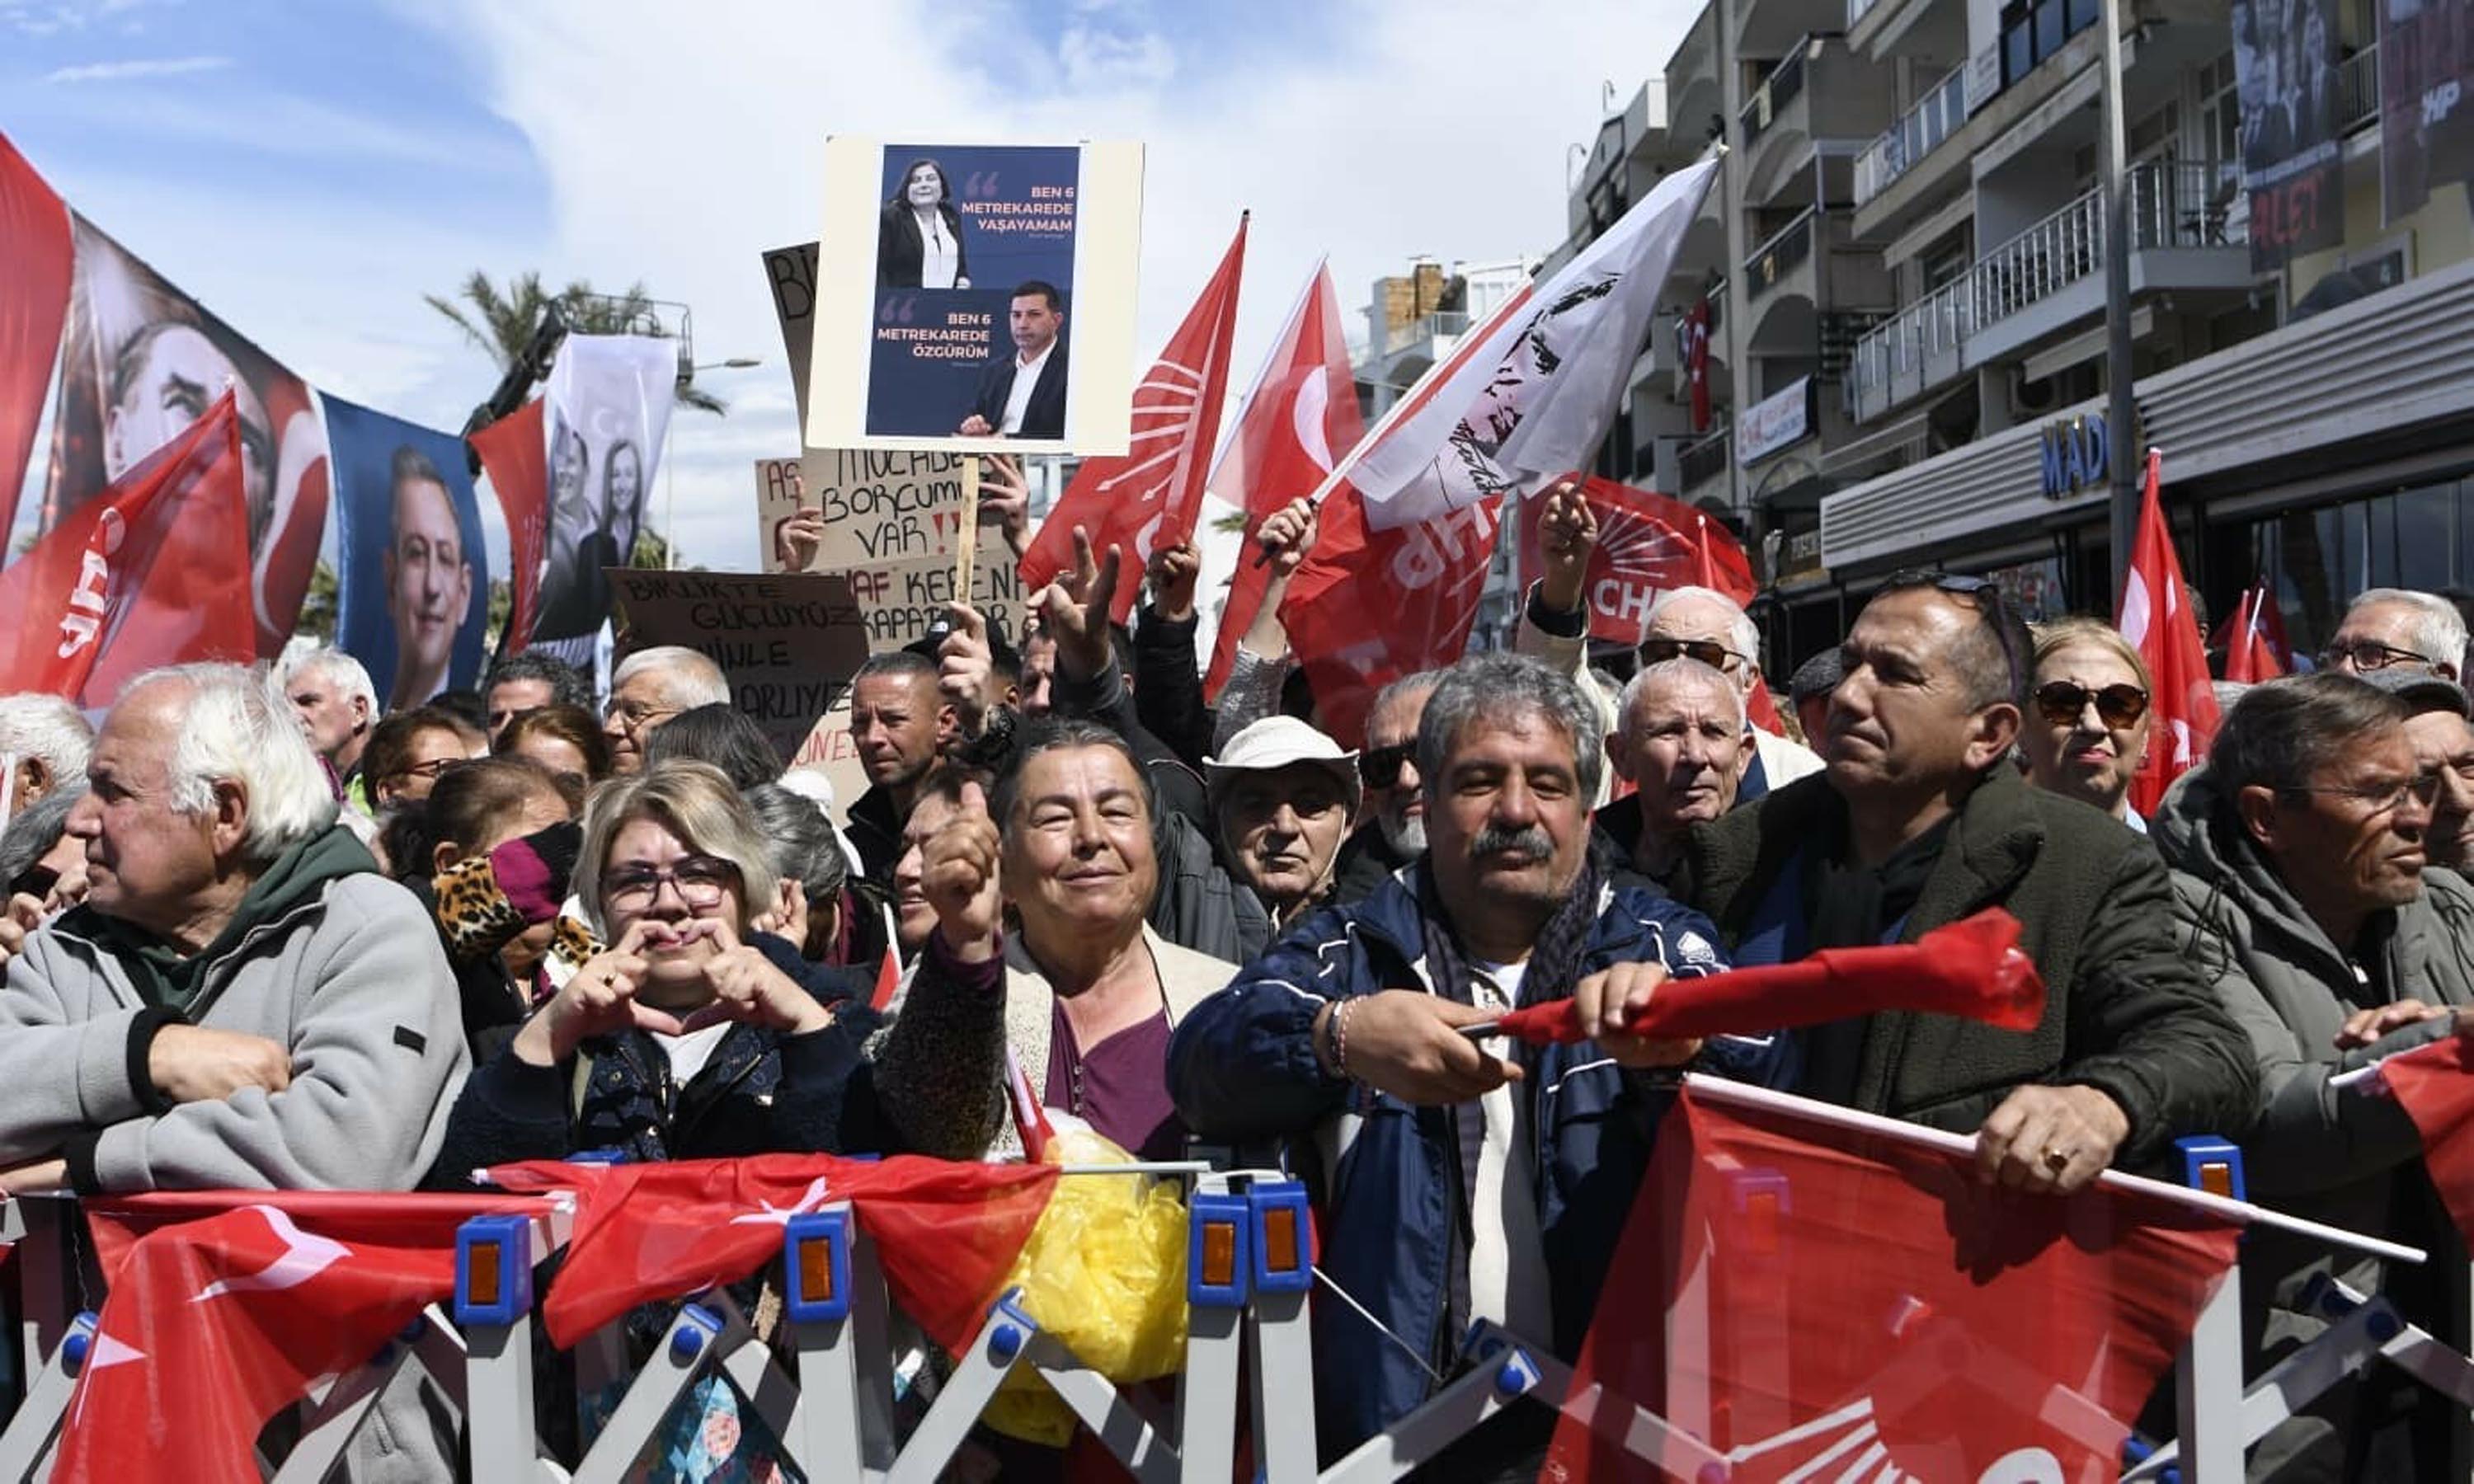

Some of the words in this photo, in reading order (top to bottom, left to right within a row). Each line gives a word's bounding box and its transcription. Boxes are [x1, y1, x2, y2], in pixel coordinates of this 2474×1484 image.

[1031, 186, 1061, 198] BEN
[1065, 186, 1075, 198] 6
[962, 202, 1074, 215] METREKAREDE
[978, 218, 1072, 233] YAŞAYAMAM
[948, 312, 978, 325] BEN
[981, 313, 991, 325] 6
[877, 328, 990, 342] METREKAREDE
[912, 343, 989, 359] ÖZGÜRÜM
[2040, 414, 2111, 496] MAD
[1593, 579, 1658, 626] CH
